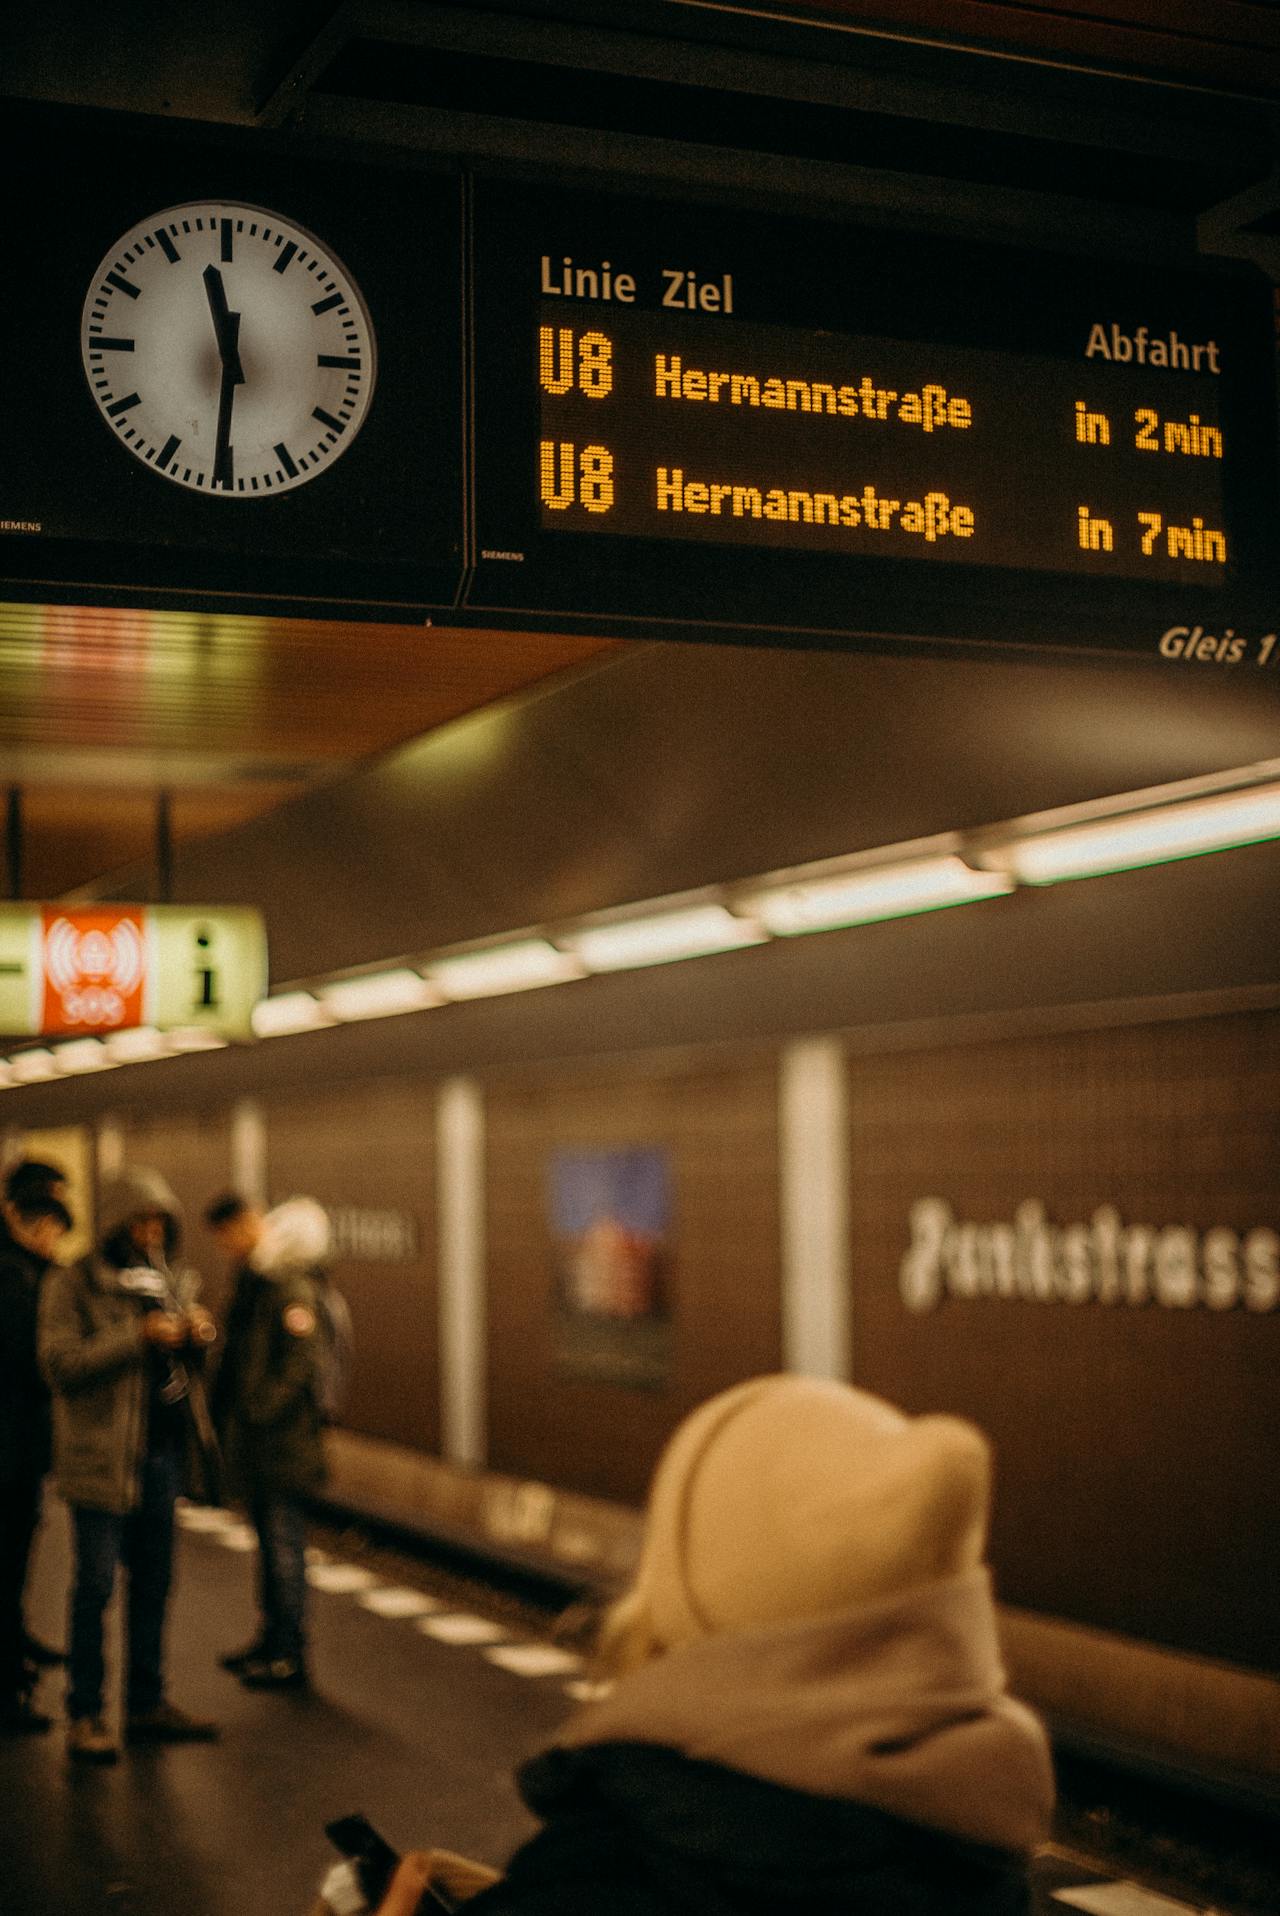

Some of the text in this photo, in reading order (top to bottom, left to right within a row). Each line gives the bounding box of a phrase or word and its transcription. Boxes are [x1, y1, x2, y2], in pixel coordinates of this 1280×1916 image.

[541, 256, 1221, 374] Linie Ziel Abfahrt
[540, 326, 1223, 458] U8 Hermannstraße in 2 min
[481, 549, 525, 562] SIEMENS
[540, 440, 1227, 563] U8 Hermannstraße in 7 min
[1158, 625, 1277, 666] Gleis 1
